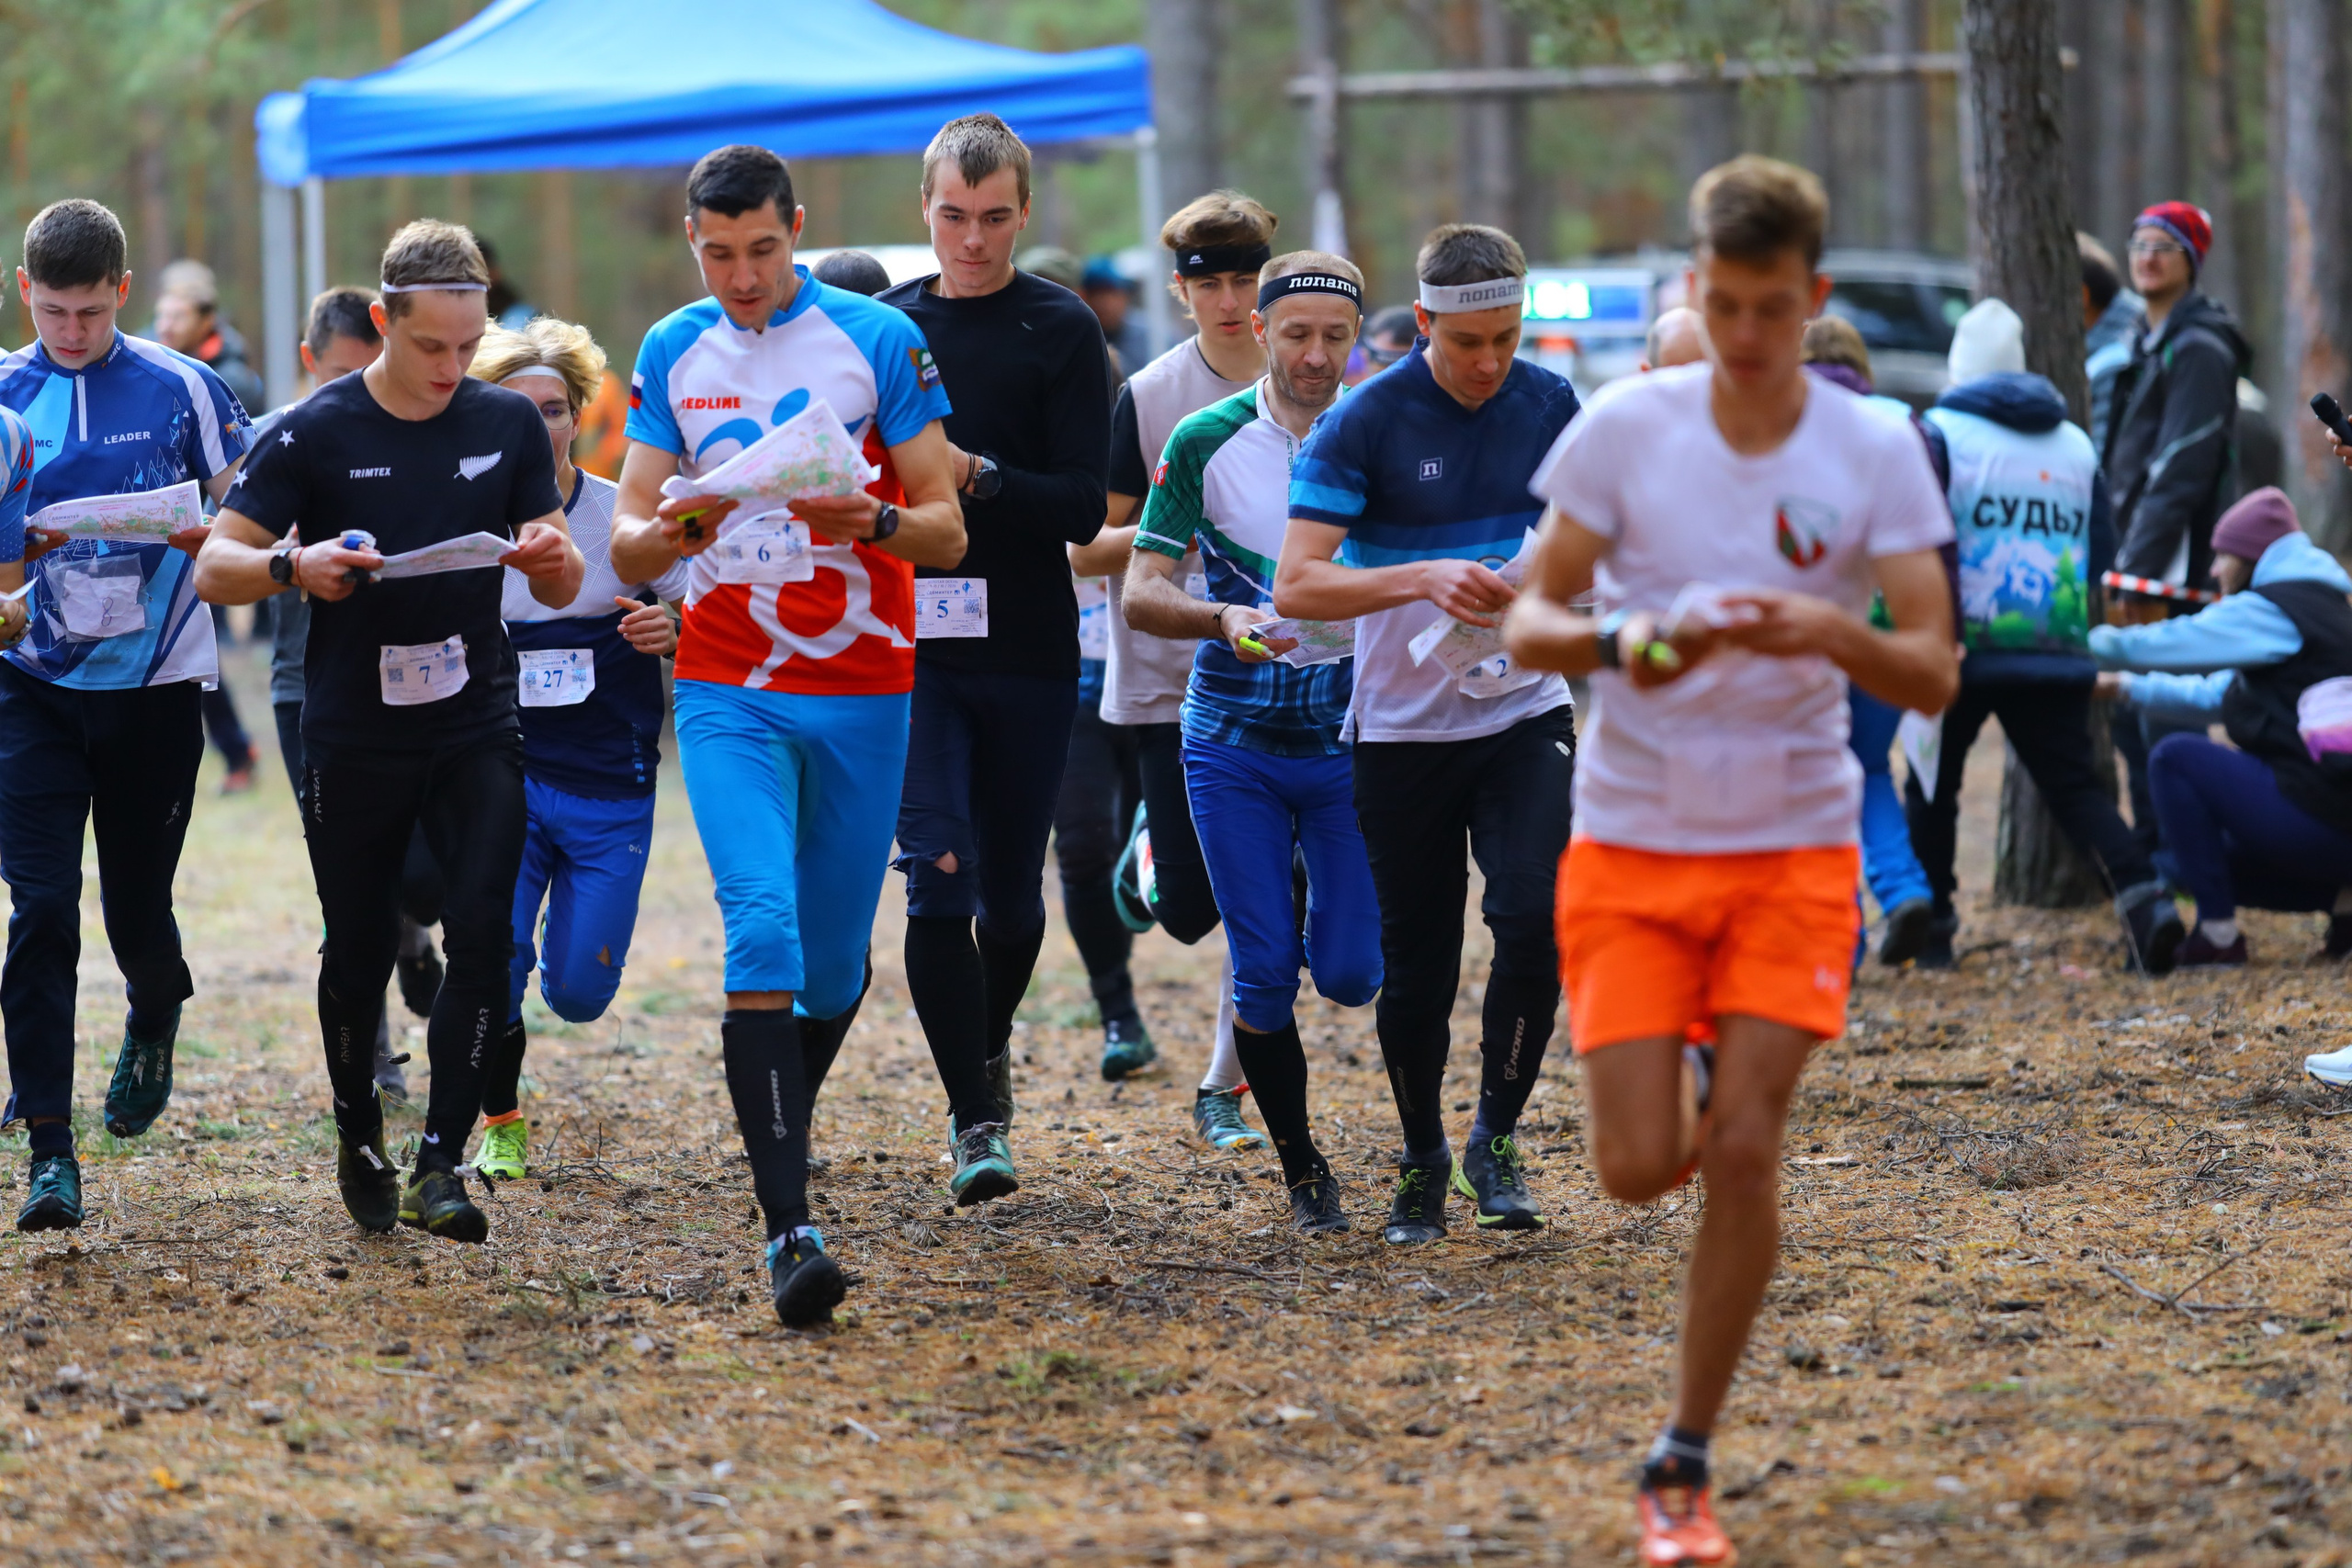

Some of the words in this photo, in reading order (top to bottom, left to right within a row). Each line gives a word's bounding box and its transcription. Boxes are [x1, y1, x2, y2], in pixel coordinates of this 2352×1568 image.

[1288, 276, 1357, 297] noname
[104, 431, 151, 445] LEADER
[349, 467, 391, 479] TRIMTEX
[758, 542, 770, 562] 6
[101, 596, 114, 626] 8
[937, 600, 948, 618] 5
[419, 665, 430, 684] 7
[1497, 659, 1508, 678] 2
[543, 670, 563, 688] 27
